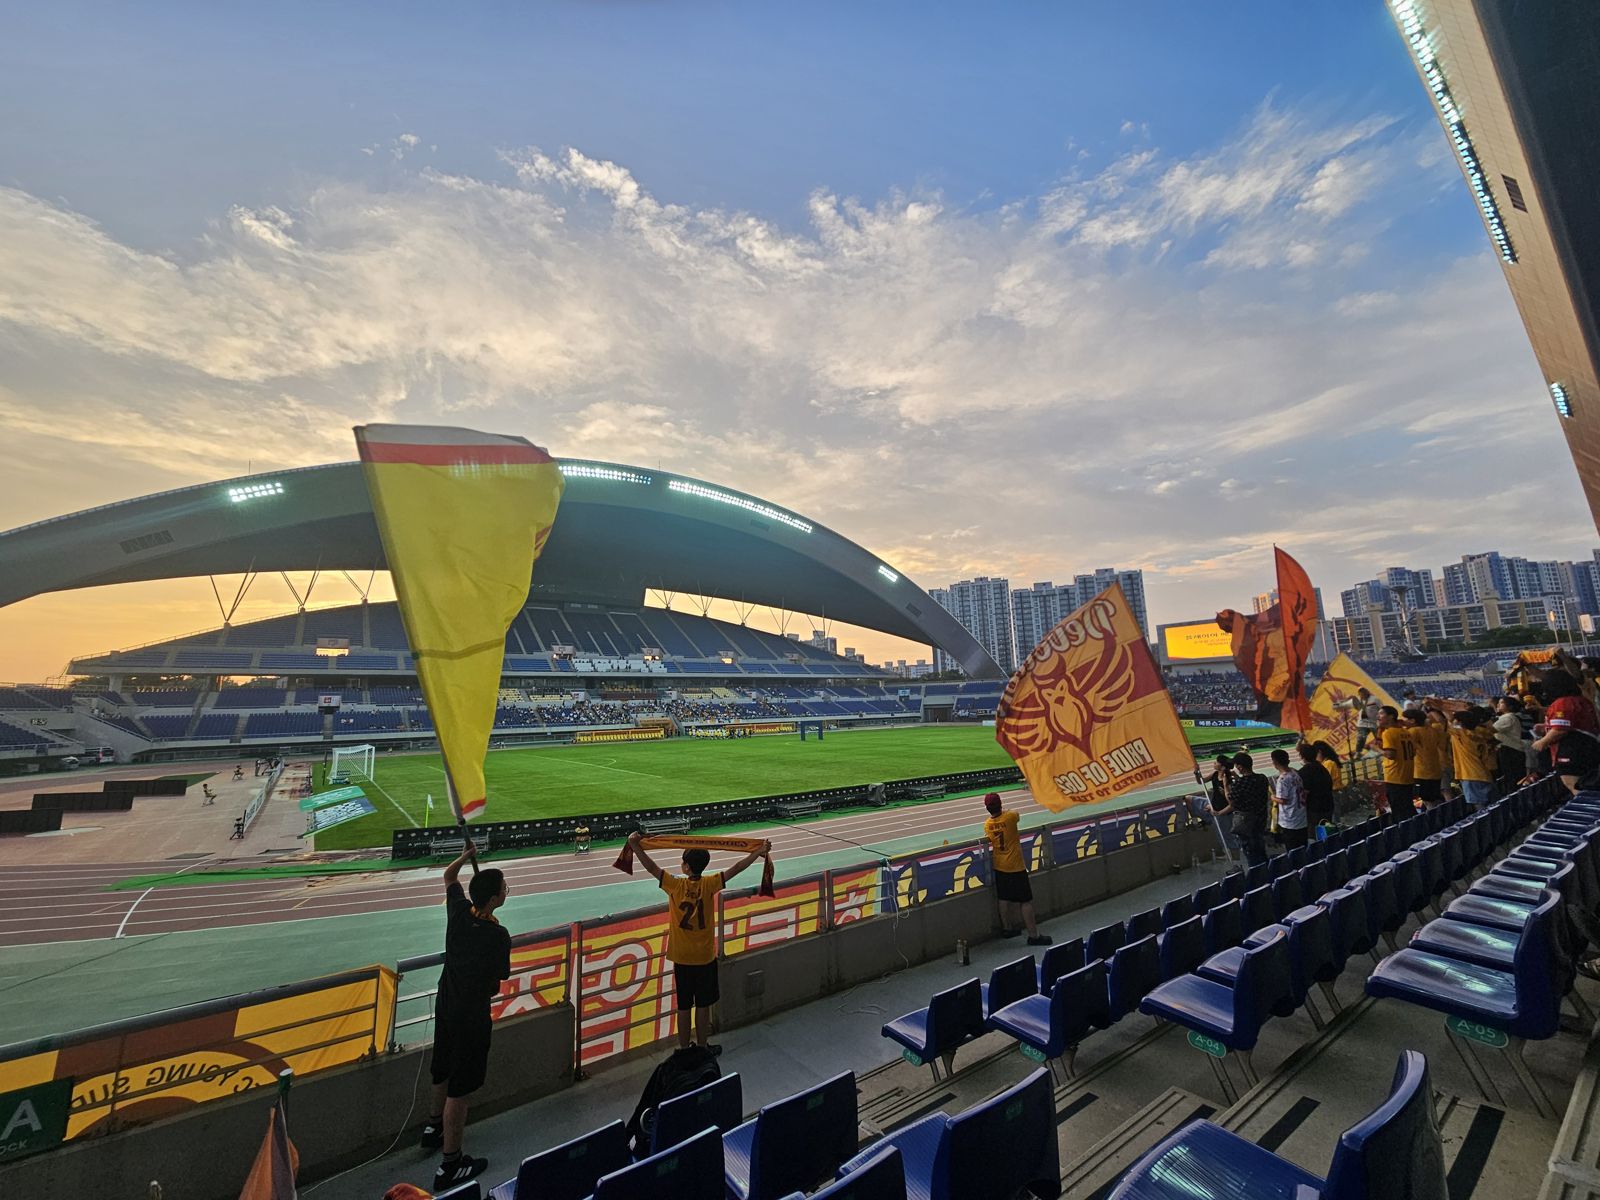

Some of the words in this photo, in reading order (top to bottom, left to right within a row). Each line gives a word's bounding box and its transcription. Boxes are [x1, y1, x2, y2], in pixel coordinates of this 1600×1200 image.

[678, 898, 705, 930] 21
[1457, 1019, 1496, 1038] A-05
[1195, 1034, 1219, 1050] A-04
[0, 1099, 42, 1140] A
